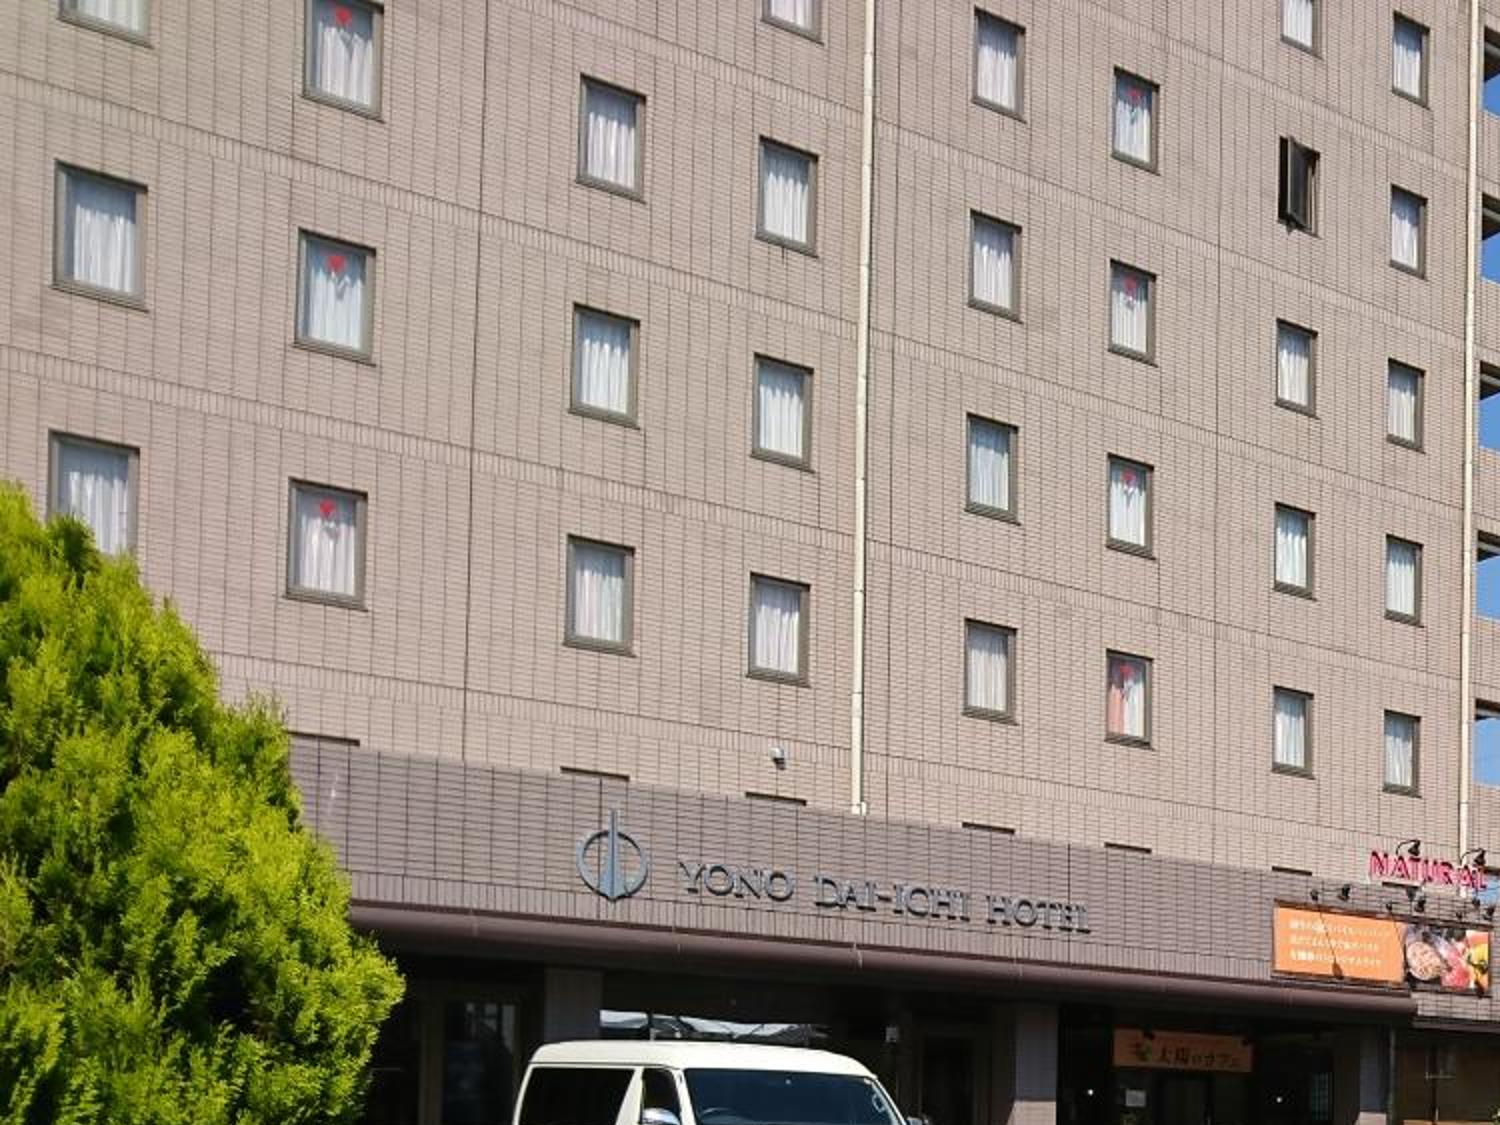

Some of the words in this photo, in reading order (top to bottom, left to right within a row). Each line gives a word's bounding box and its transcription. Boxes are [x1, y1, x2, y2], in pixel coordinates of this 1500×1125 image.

[679, 861, 794, 901] YONO
[815, 875, 970, 922] DAI-ICHI
[986, 896, 1091, 933] HOTEL
[1370, 850, 1487, 889] NATURAL
